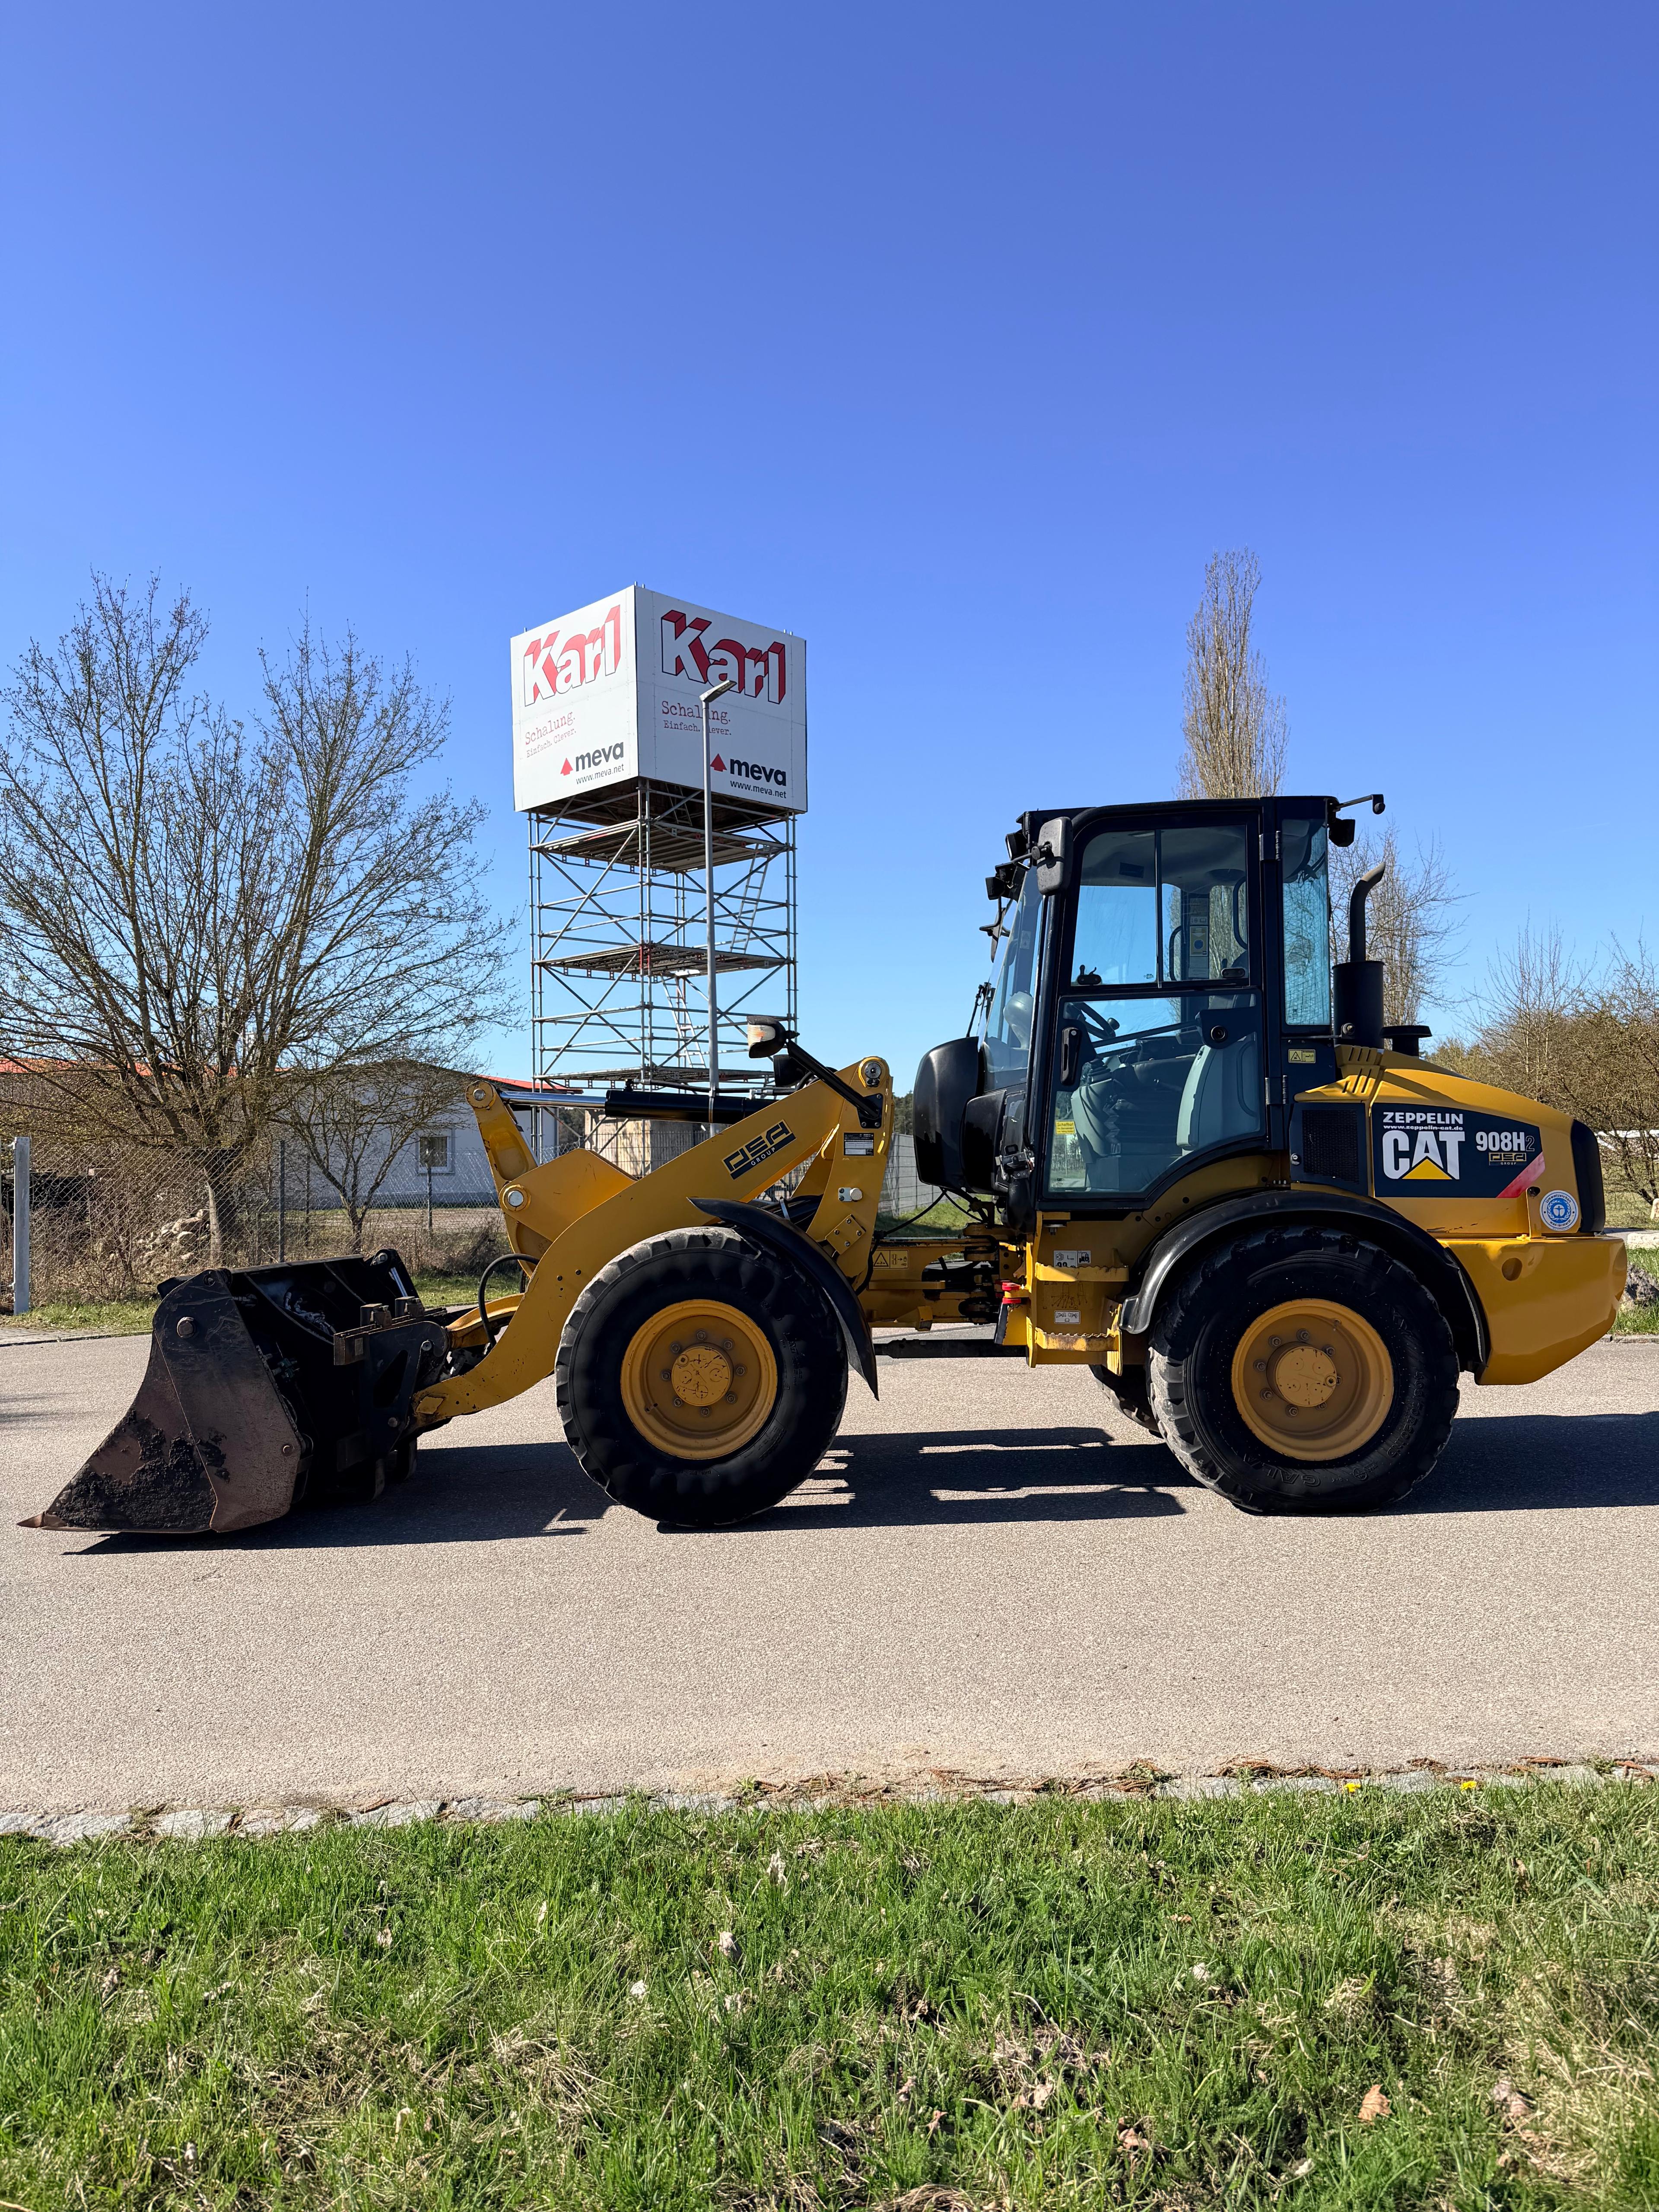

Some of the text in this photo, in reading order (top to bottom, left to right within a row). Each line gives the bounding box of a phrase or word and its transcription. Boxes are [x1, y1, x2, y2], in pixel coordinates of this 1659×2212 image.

[524, 604, 621, 707] Karl
[661, 610, 786, 705] Karl
[662, 700, 731, 725] Schalng.
[663, 720, 700, 732] Einfach.
[525, 712, 575, 745] Schalung.
[526, 728, 576, 758] Einfach. Clever.
[575, 742, 624, 772] meva
[576, 763, 624, 785] www.meva.net
[730, 758, 786, 787] meva
[730, 780, 786, 798] www.meva.net
[1383, 1112, 1463, 1125] ZEPPELIN
[750, 1147, 775, 1166] GROUP
[1382, 1130, 1465, 1180] CAT
